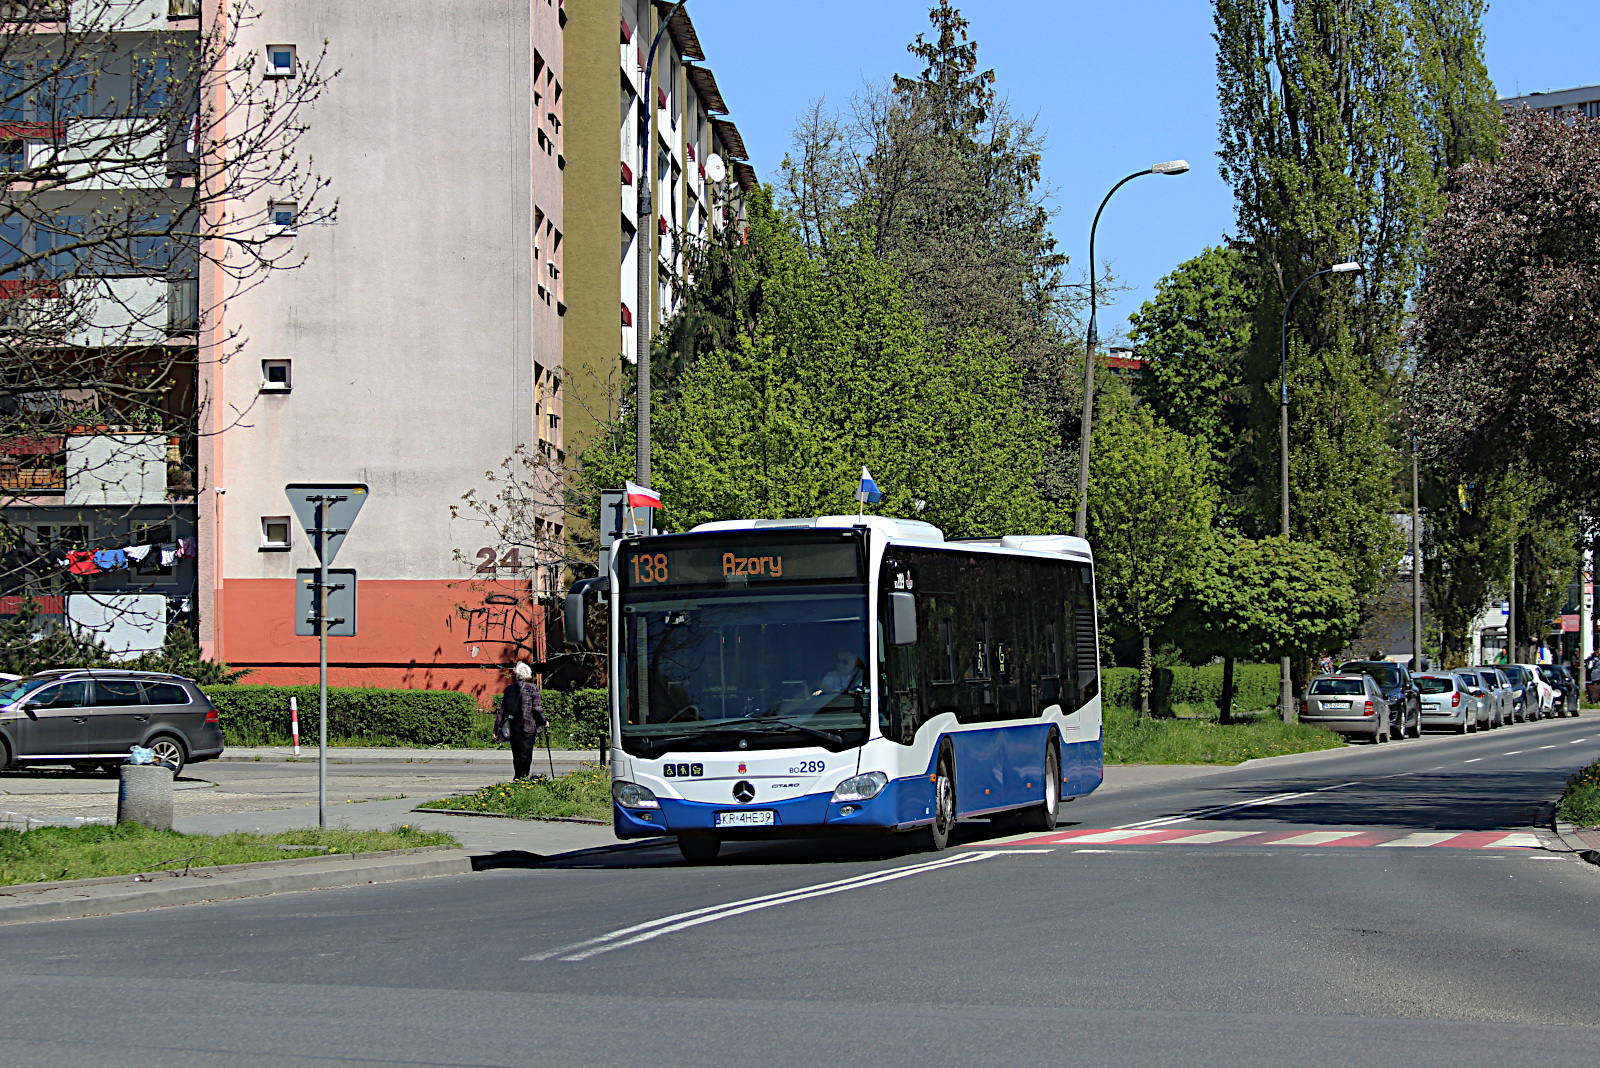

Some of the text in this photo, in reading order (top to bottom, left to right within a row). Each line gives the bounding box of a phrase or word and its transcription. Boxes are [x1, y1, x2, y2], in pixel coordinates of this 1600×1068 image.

[476, 547, 522, 574] 24
[630, 553, 669, 584] 138
[722, 552, 783, 578] Azory
